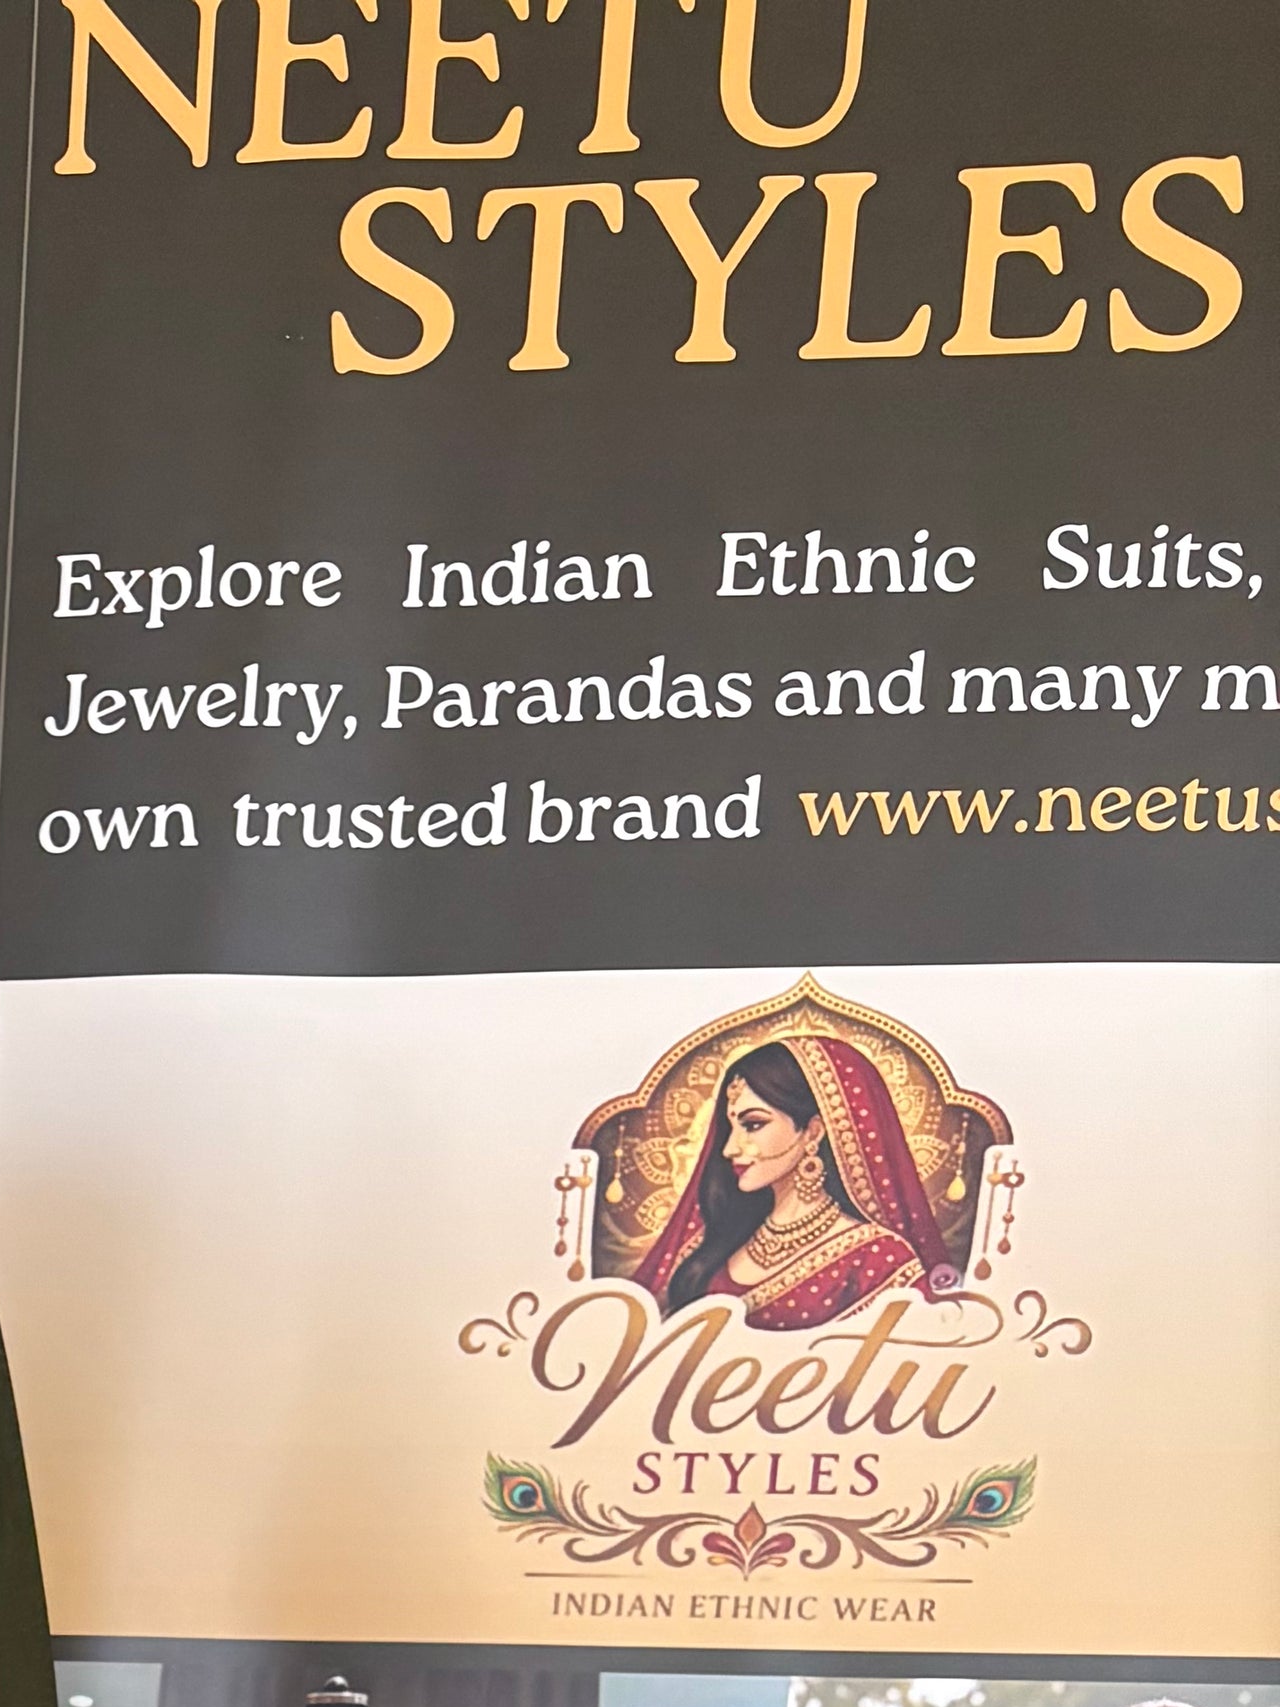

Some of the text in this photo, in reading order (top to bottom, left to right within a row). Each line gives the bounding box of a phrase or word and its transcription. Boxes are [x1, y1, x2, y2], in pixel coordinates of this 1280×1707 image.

[55, 0, 867, 174] NEETU
[331, 156, 1243, 375] STYLES
[54, 525, 1262, 628] Explore Indian Ethnic Suits,
[45, 664, 357, 745] Jewelry,
[381, 655, 751, 728] Parandas
[775, 650, 925, 716] and
[948, 666, 1182, 727] many
[39, 804, 198, 853] own
[234, 782, 507, 848] trusted
[529, 775, 761, 842] brand
[531, 1291, 1003, 1449] Neetu
[633, 1452, 879, 1496] STYLES
[553, 1593, 935, 1621] INDIAN ETHNIC WEAR
